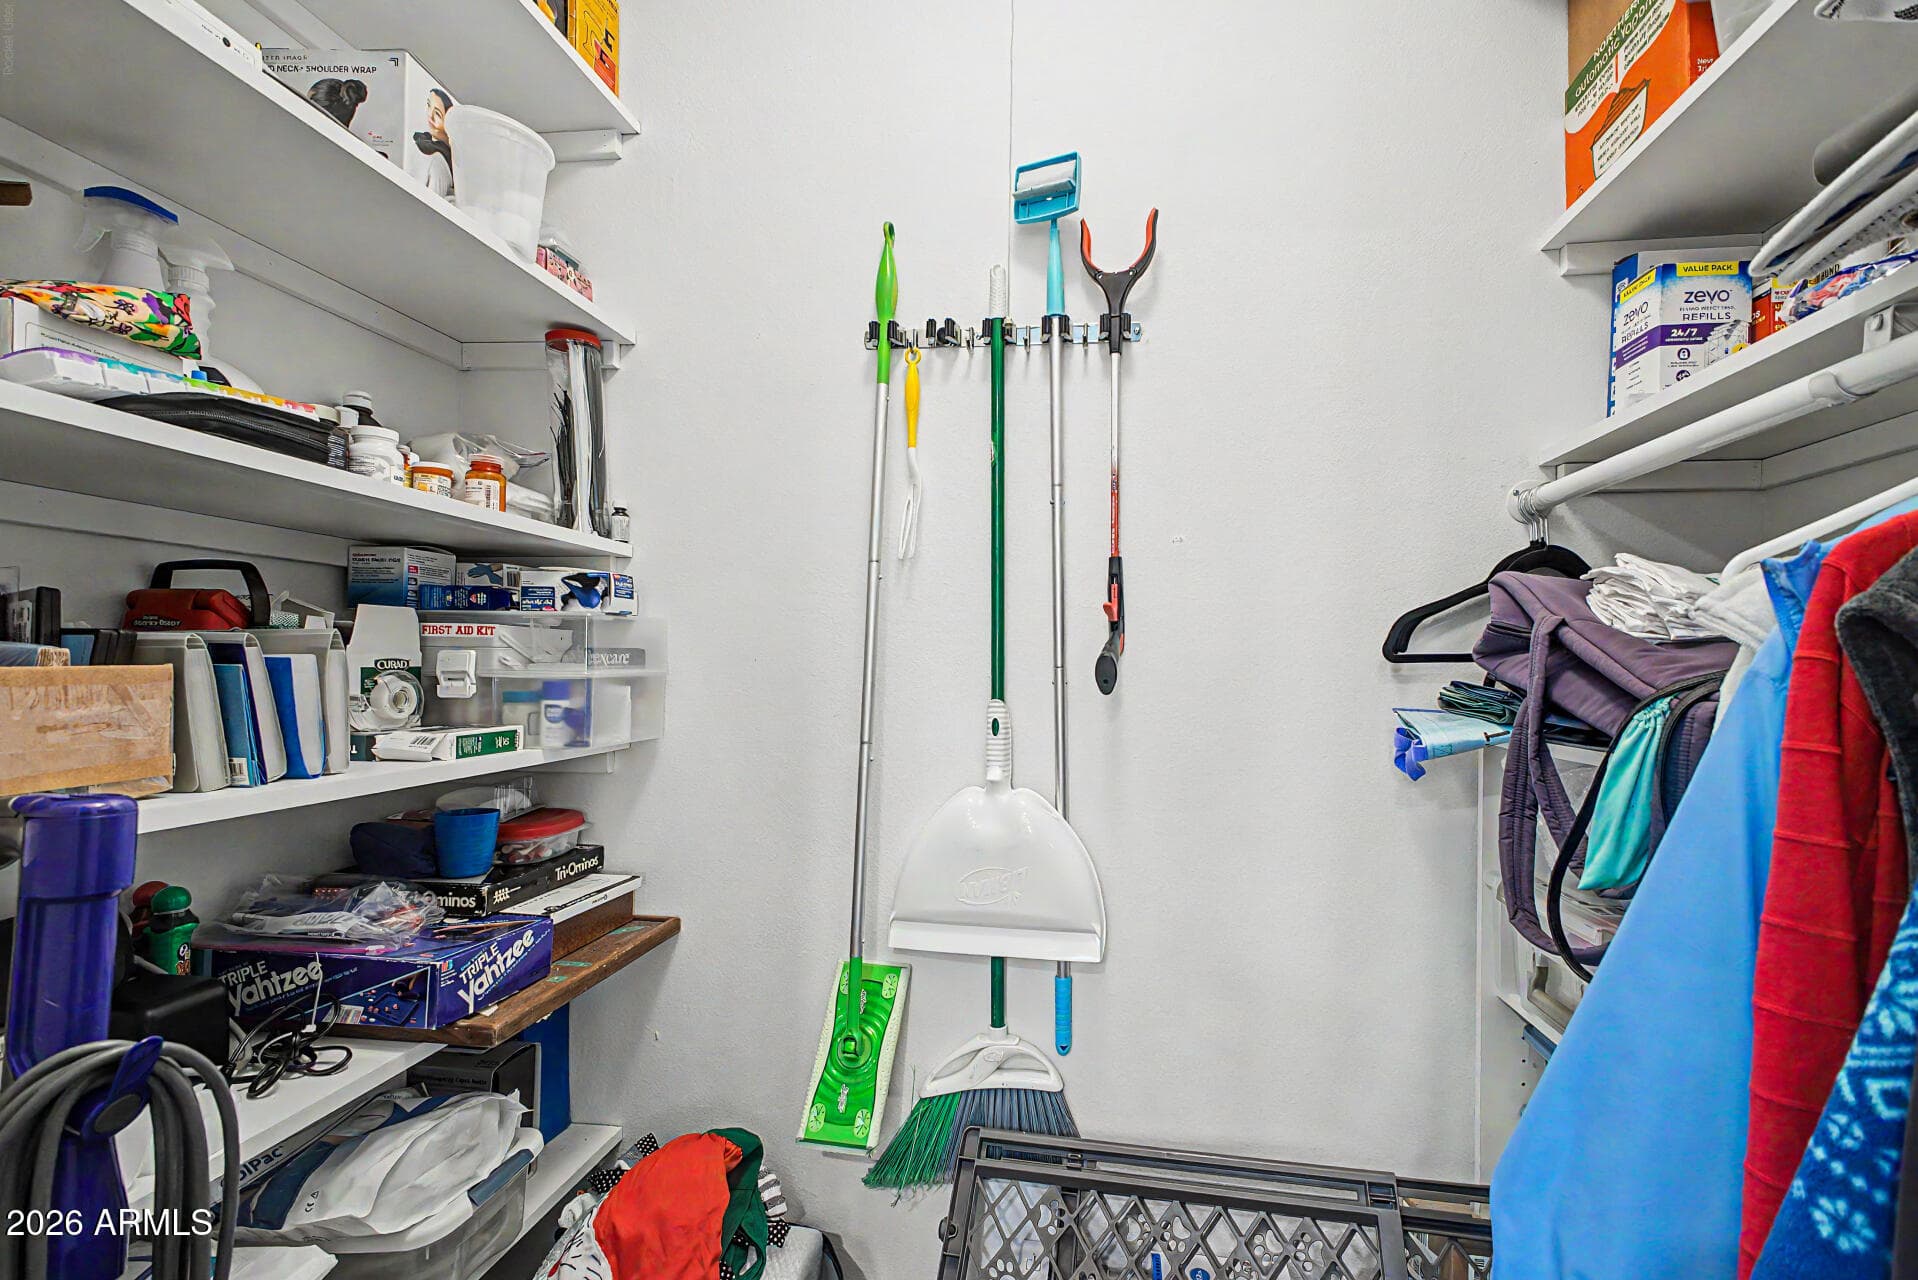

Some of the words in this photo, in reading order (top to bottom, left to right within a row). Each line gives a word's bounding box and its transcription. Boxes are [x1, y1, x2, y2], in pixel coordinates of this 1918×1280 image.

[305, 65, 349, 73] SHOULDER
[351, 65, 377, 74] WRAP
[1683, 264, 1709, 272] VALUE
[1711, 263, 1734, 271] PACK
[1683, 289, 1730, 305] zevo
[1682, 311, 1731, 321] REFILLS
[1670, 327, 1698, 337] 24/7
[421, 624, 452, 636] FIRST
[455, 624, 474, 635] AID
[476, 625, 497, 636] KIT
[376, 660, 408, 670] CURAD
[458, 941, 500, 985] TRIPLE
[218, 960, 268, 987] TRIPLE
